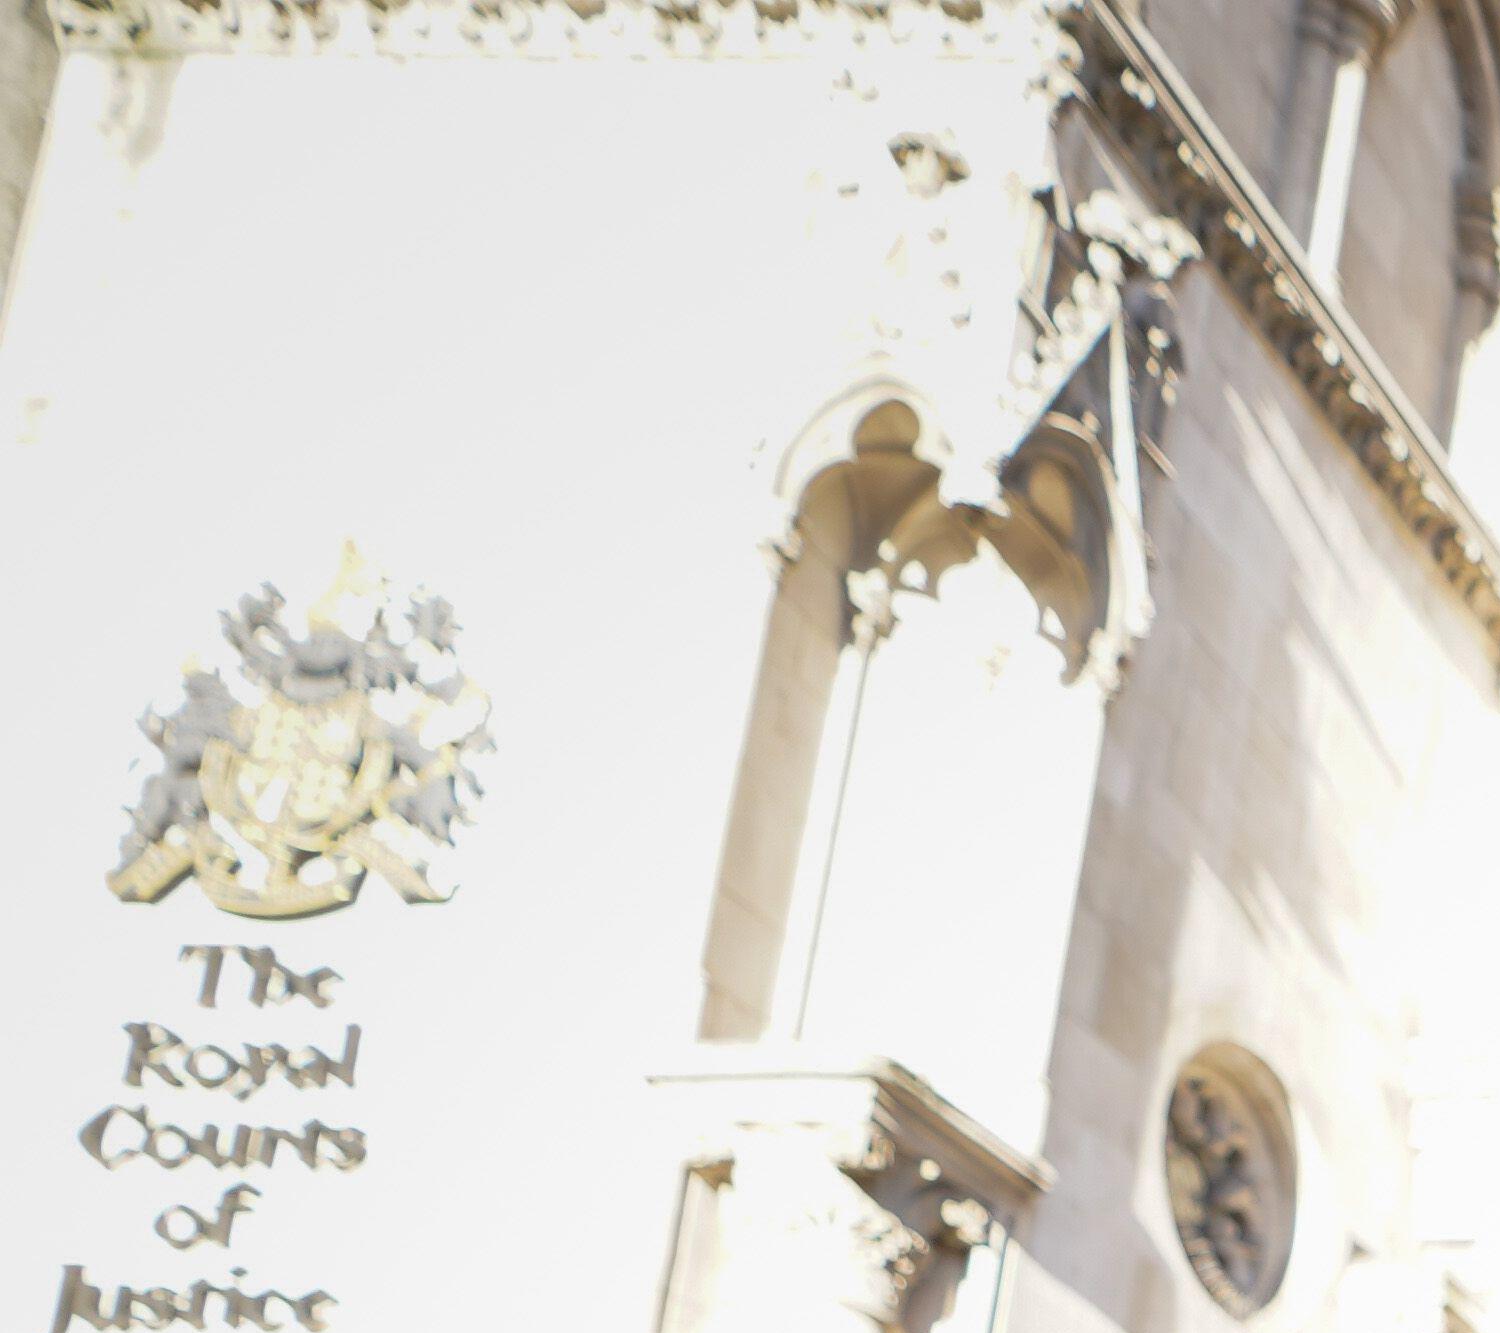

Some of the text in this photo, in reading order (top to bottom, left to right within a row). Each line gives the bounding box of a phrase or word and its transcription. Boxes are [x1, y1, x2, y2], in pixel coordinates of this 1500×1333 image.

[178, 944, 344, 1008] The
[122, 1022, 362, 1102] Royal
[78, 1104, 367, 1170] Courts
[153, 1181, 262, 1250] of
